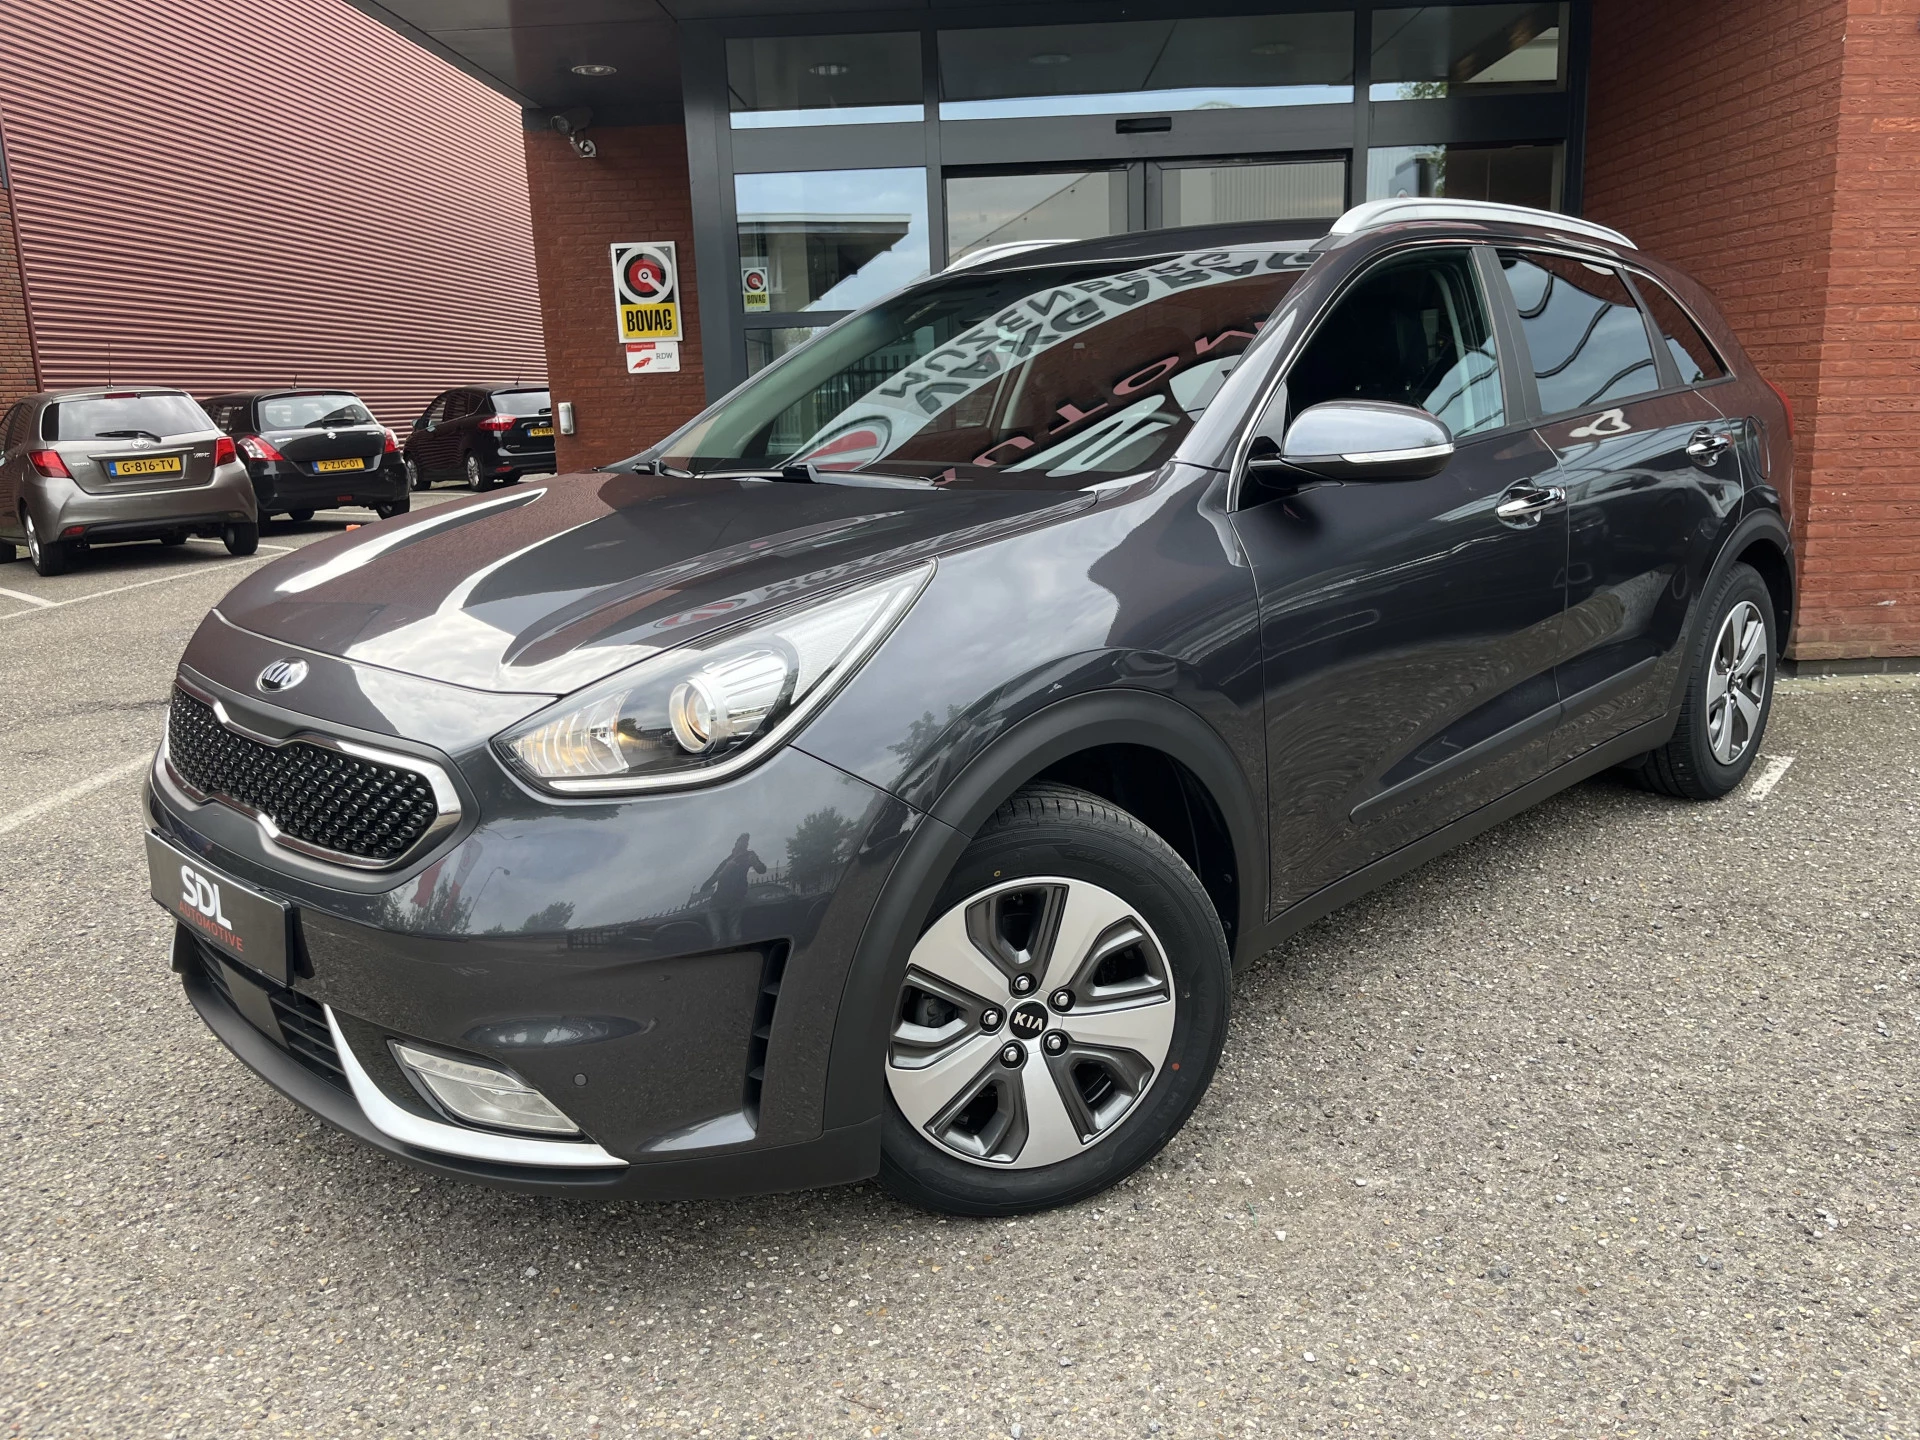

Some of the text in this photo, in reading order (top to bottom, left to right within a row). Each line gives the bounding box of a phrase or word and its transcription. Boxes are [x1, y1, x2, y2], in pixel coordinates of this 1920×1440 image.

[747, 294, 766, 304] BOVAG
[626, 308, 672, 332] BOVAG
[656, 352, 673, 360] RDW
[122, 459, 174, 473] G-816-TV
[323, 460, 360, 470] 2-ZJG-01
[181, 865, 232, 931] SDL
[179, 901, 244, 952] AUTOMOTIVE
[1013, 1011, 1043, 1031] KIA
